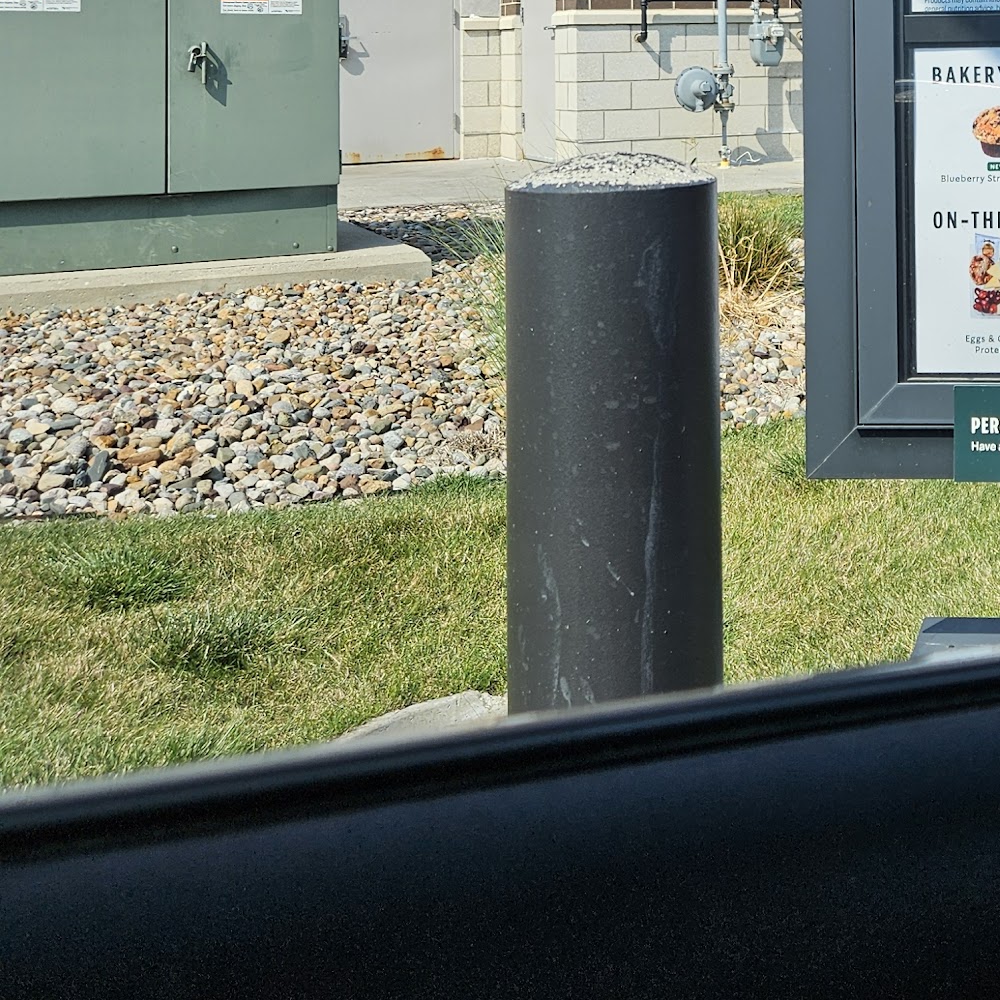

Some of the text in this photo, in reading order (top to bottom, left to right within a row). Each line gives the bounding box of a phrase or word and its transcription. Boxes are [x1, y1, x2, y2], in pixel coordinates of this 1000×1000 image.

[941, 175, 984, 184] Blueberry
[965, 335, 986, 345] Eggs
[988, 335, 995, 343] &
[971, 441, 996, 452] Have
